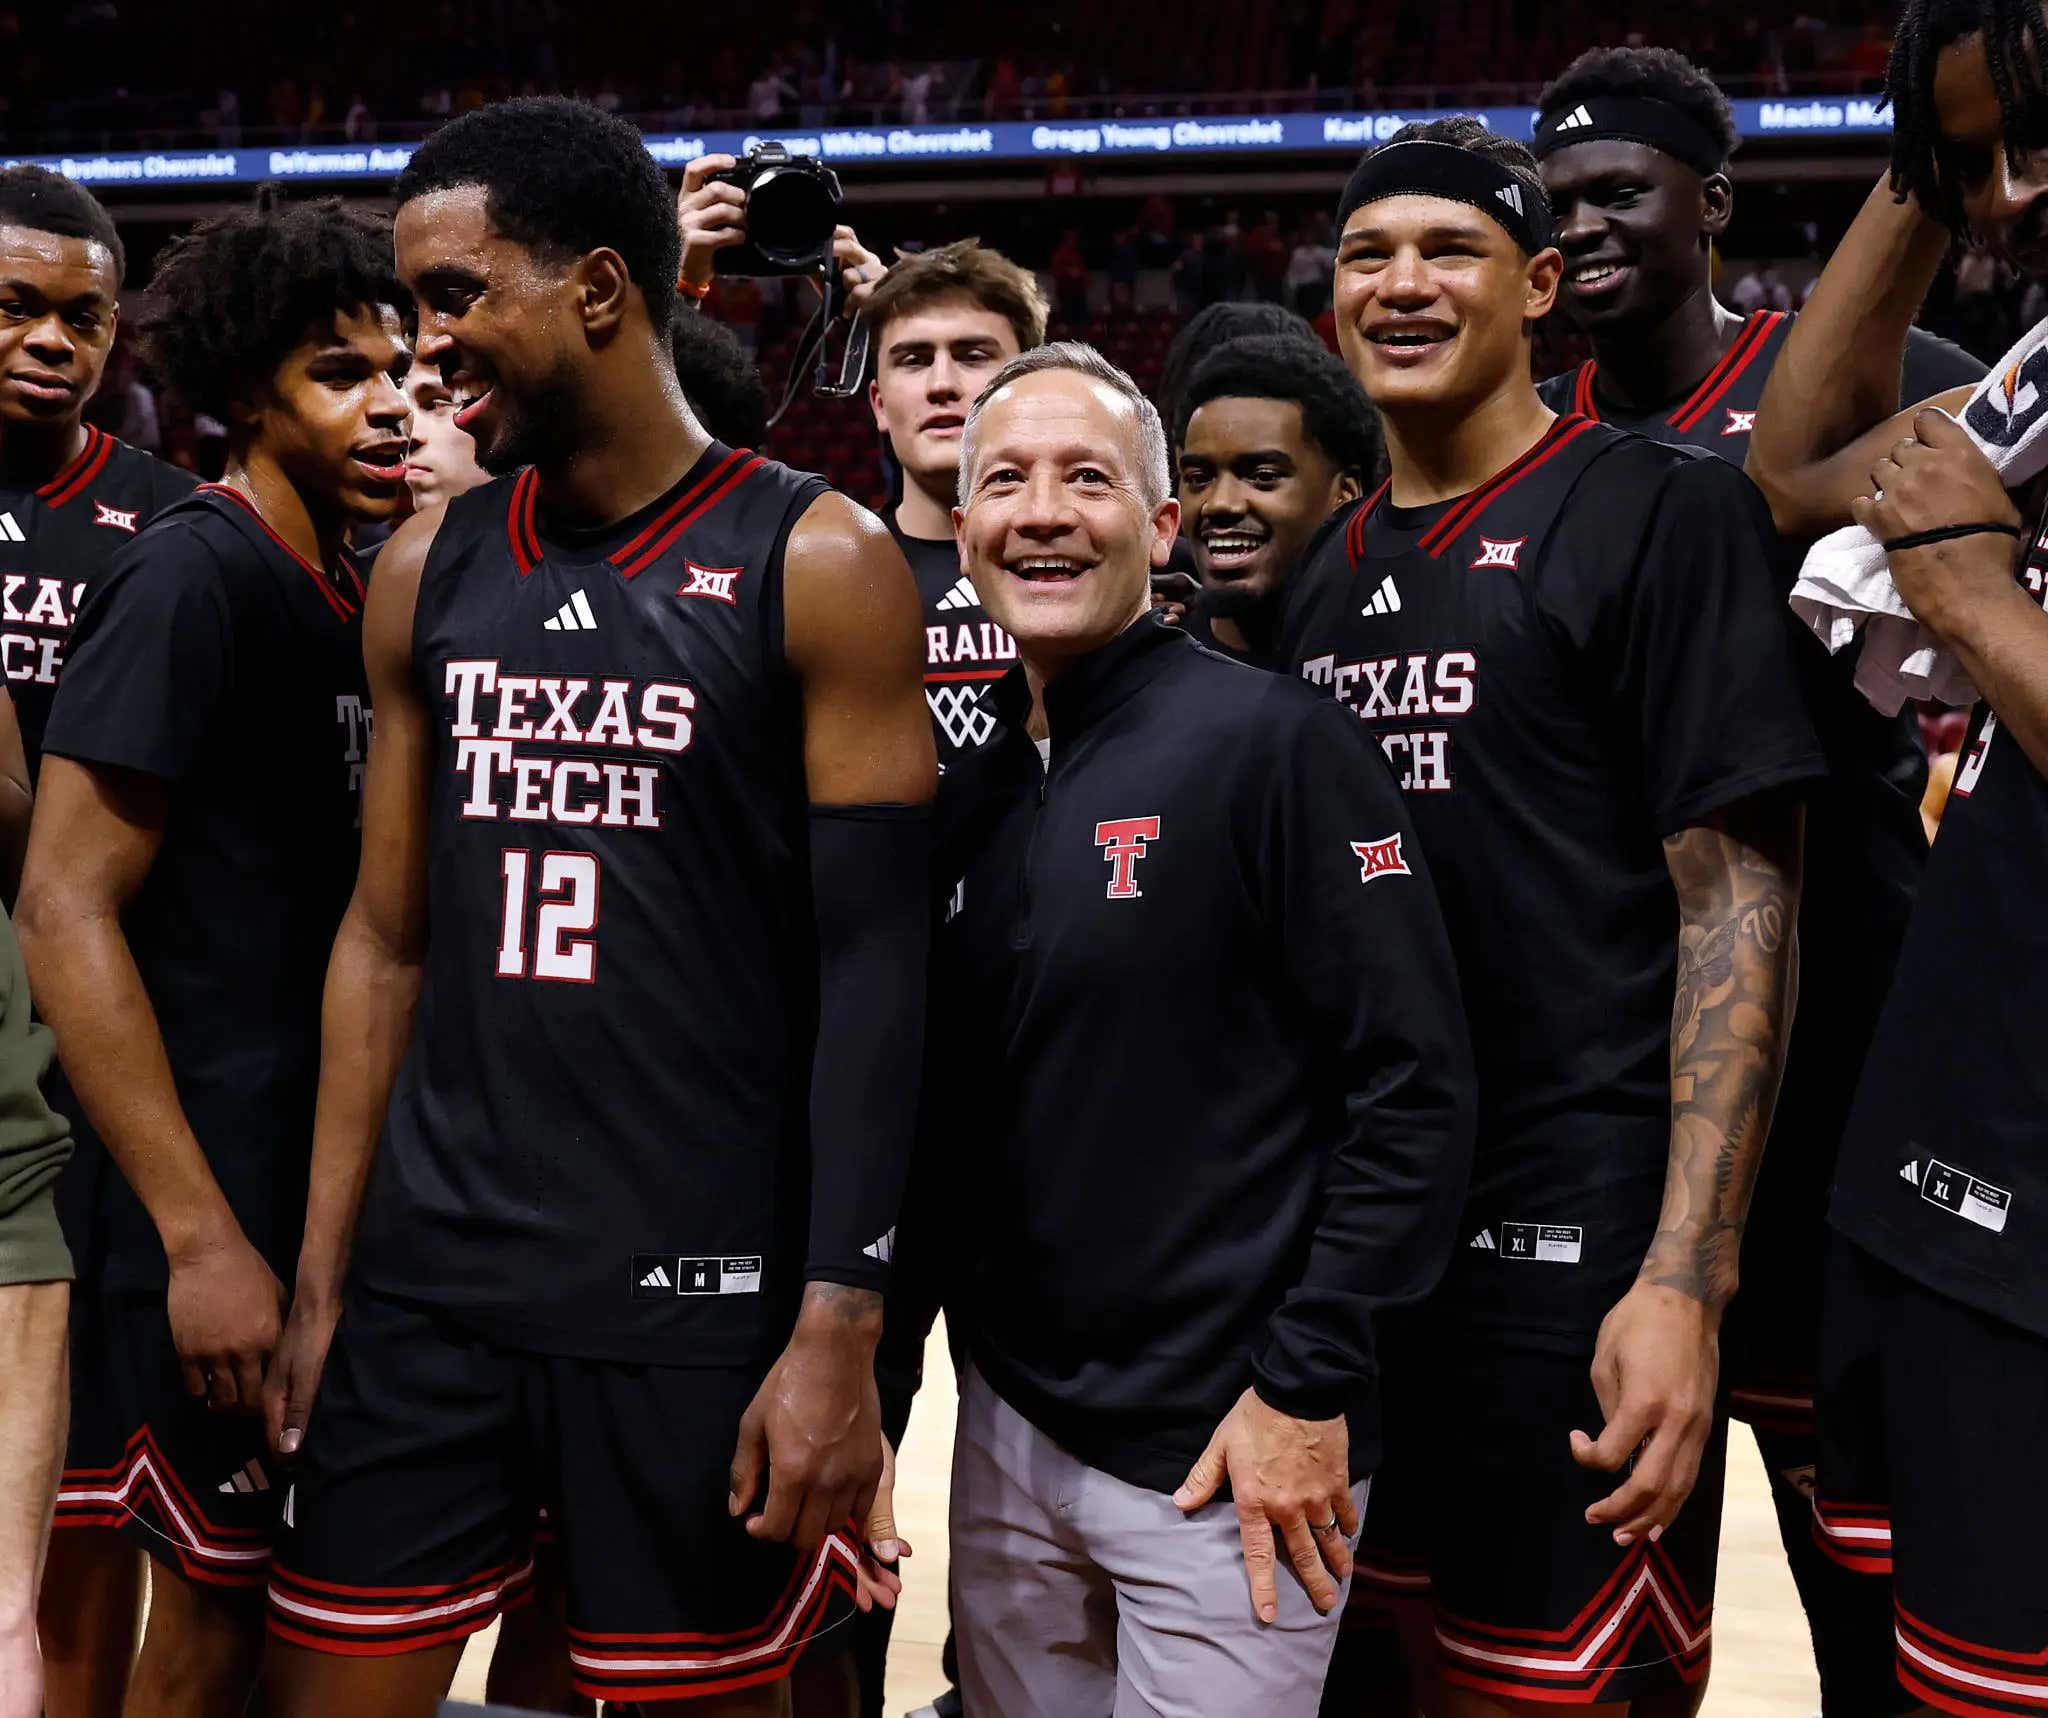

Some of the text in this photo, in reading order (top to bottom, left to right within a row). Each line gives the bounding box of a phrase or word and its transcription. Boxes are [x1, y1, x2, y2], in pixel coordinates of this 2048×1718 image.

[820, 131, 886, 156] White
[887, 128, 993, 153] Chevrolet
[1032, 120, 1283, 153] Gregg Young Chevrolet
[1324, 115, 1373, 141] Karl
[143, 155, 236, 178] Chevrolet
[925, 622, 1018, 665] RAID
[444, 658, 697, 754] TEXAS
[455, 739, 664, 830] TECH
[495, 847, 600, 984] 12
[1932, 1180, 1949, 1201] XL
[1511, 1237, 1526, 1252] XL
[694, 1272, 705, 1287] M
